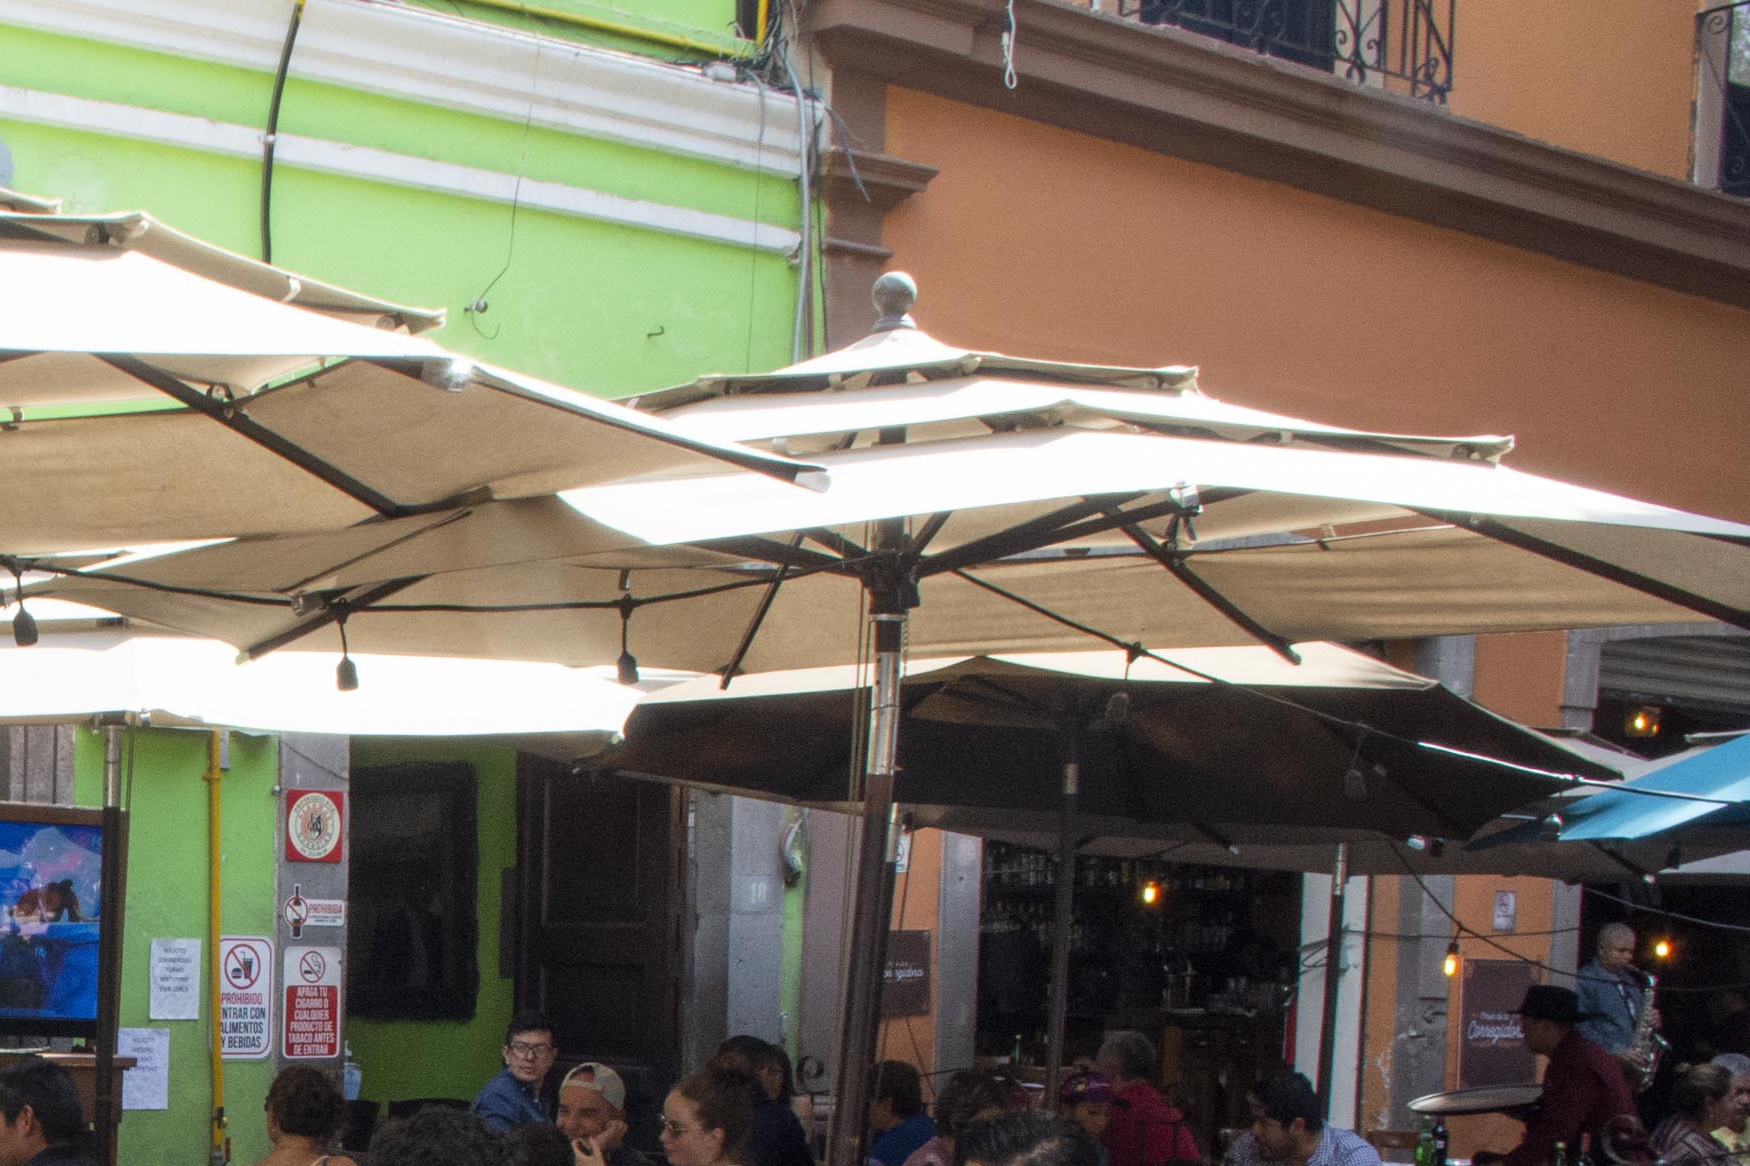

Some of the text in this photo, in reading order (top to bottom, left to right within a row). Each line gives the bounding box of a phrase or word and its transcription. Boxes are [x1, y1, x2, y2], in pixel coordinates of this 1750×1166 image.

[296, 986, 328, 997] APAGA TU
[221, 993, 263, 1005] PROHIBIDO
[295, 997, 329, 1009] CIGARRO O
[221, 1007, 266, 1019] NTRAR CON
[294, 1009, 329, 1020] CUALQUIER
[290, 1020, 333, 1032] PRODUCTO DE
[228, 1036, 262, 1048] BEBIDAS
[289, 1033, 335, 1044] TABACO ANTES
[293, 1044, 329, 1055] DE ENTRAR
